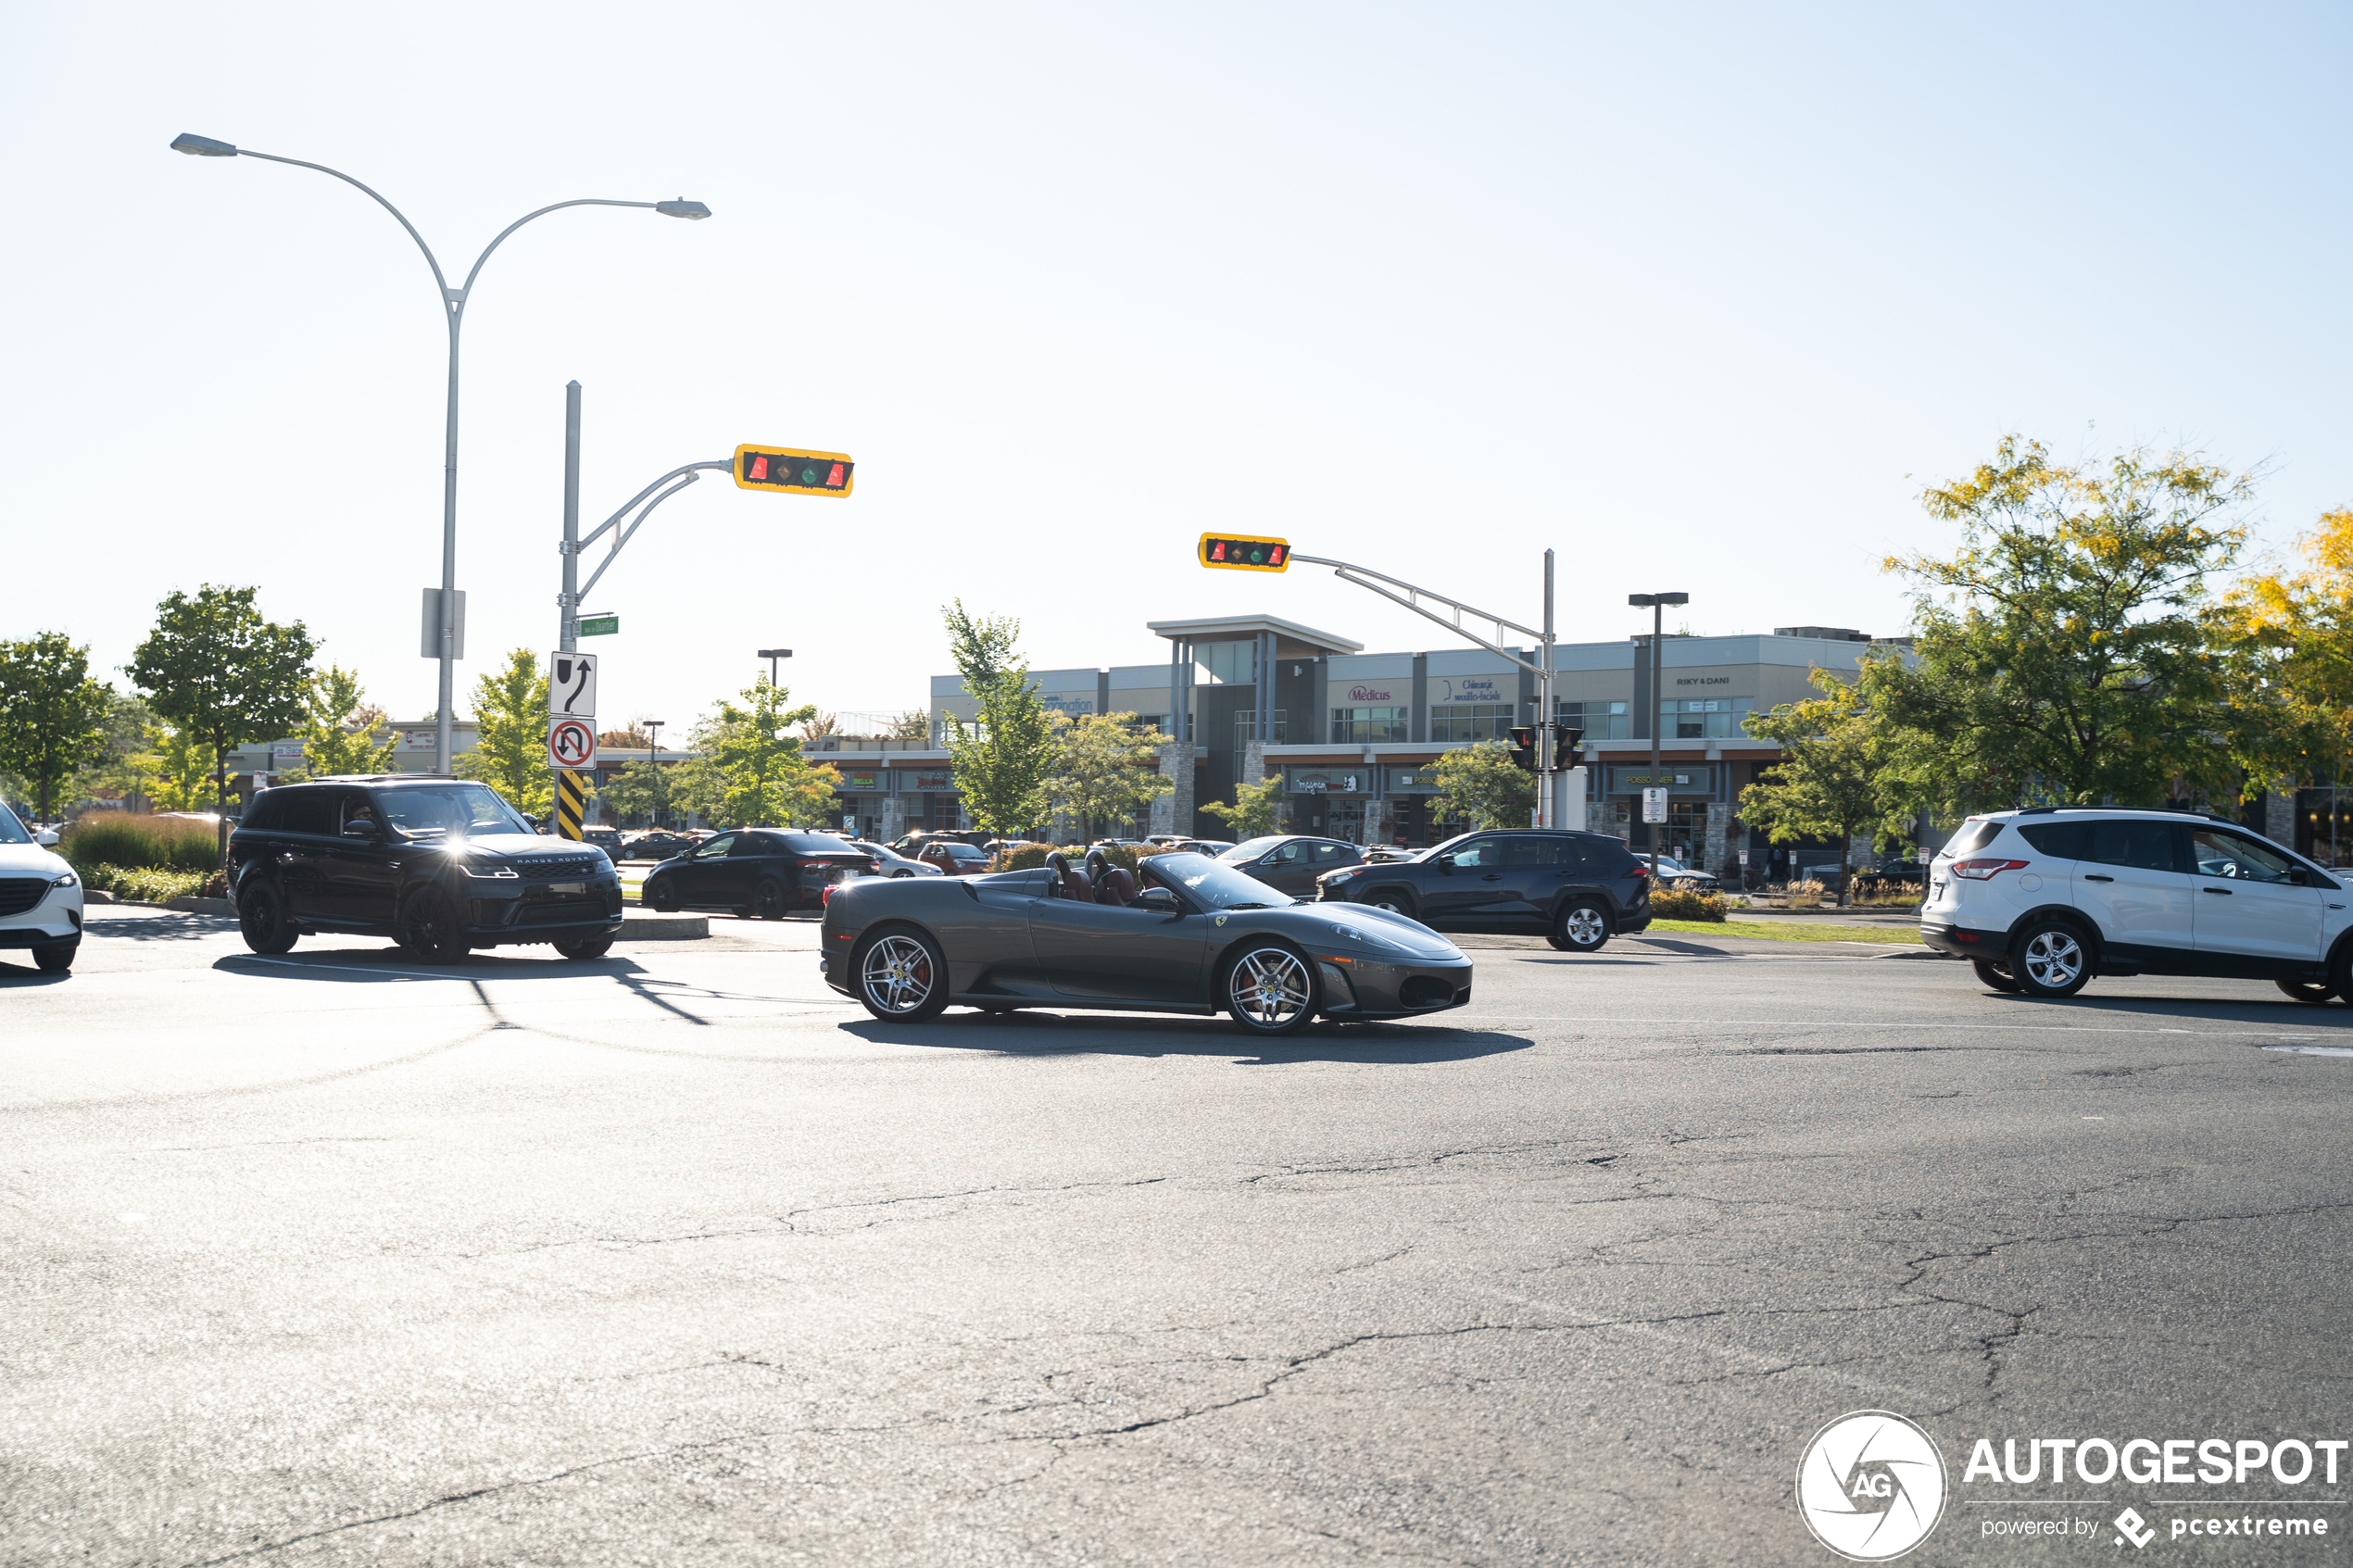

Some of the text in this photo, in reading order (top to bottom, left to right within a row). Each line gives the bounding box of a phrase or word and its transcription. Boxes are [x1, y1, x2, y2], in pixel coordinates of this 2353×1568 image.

[1706, 677, 1730, 685] DANI
[1348, 685, 1390, 701] Medicus
[1626, 775, 1673, 784] POISSOIER
